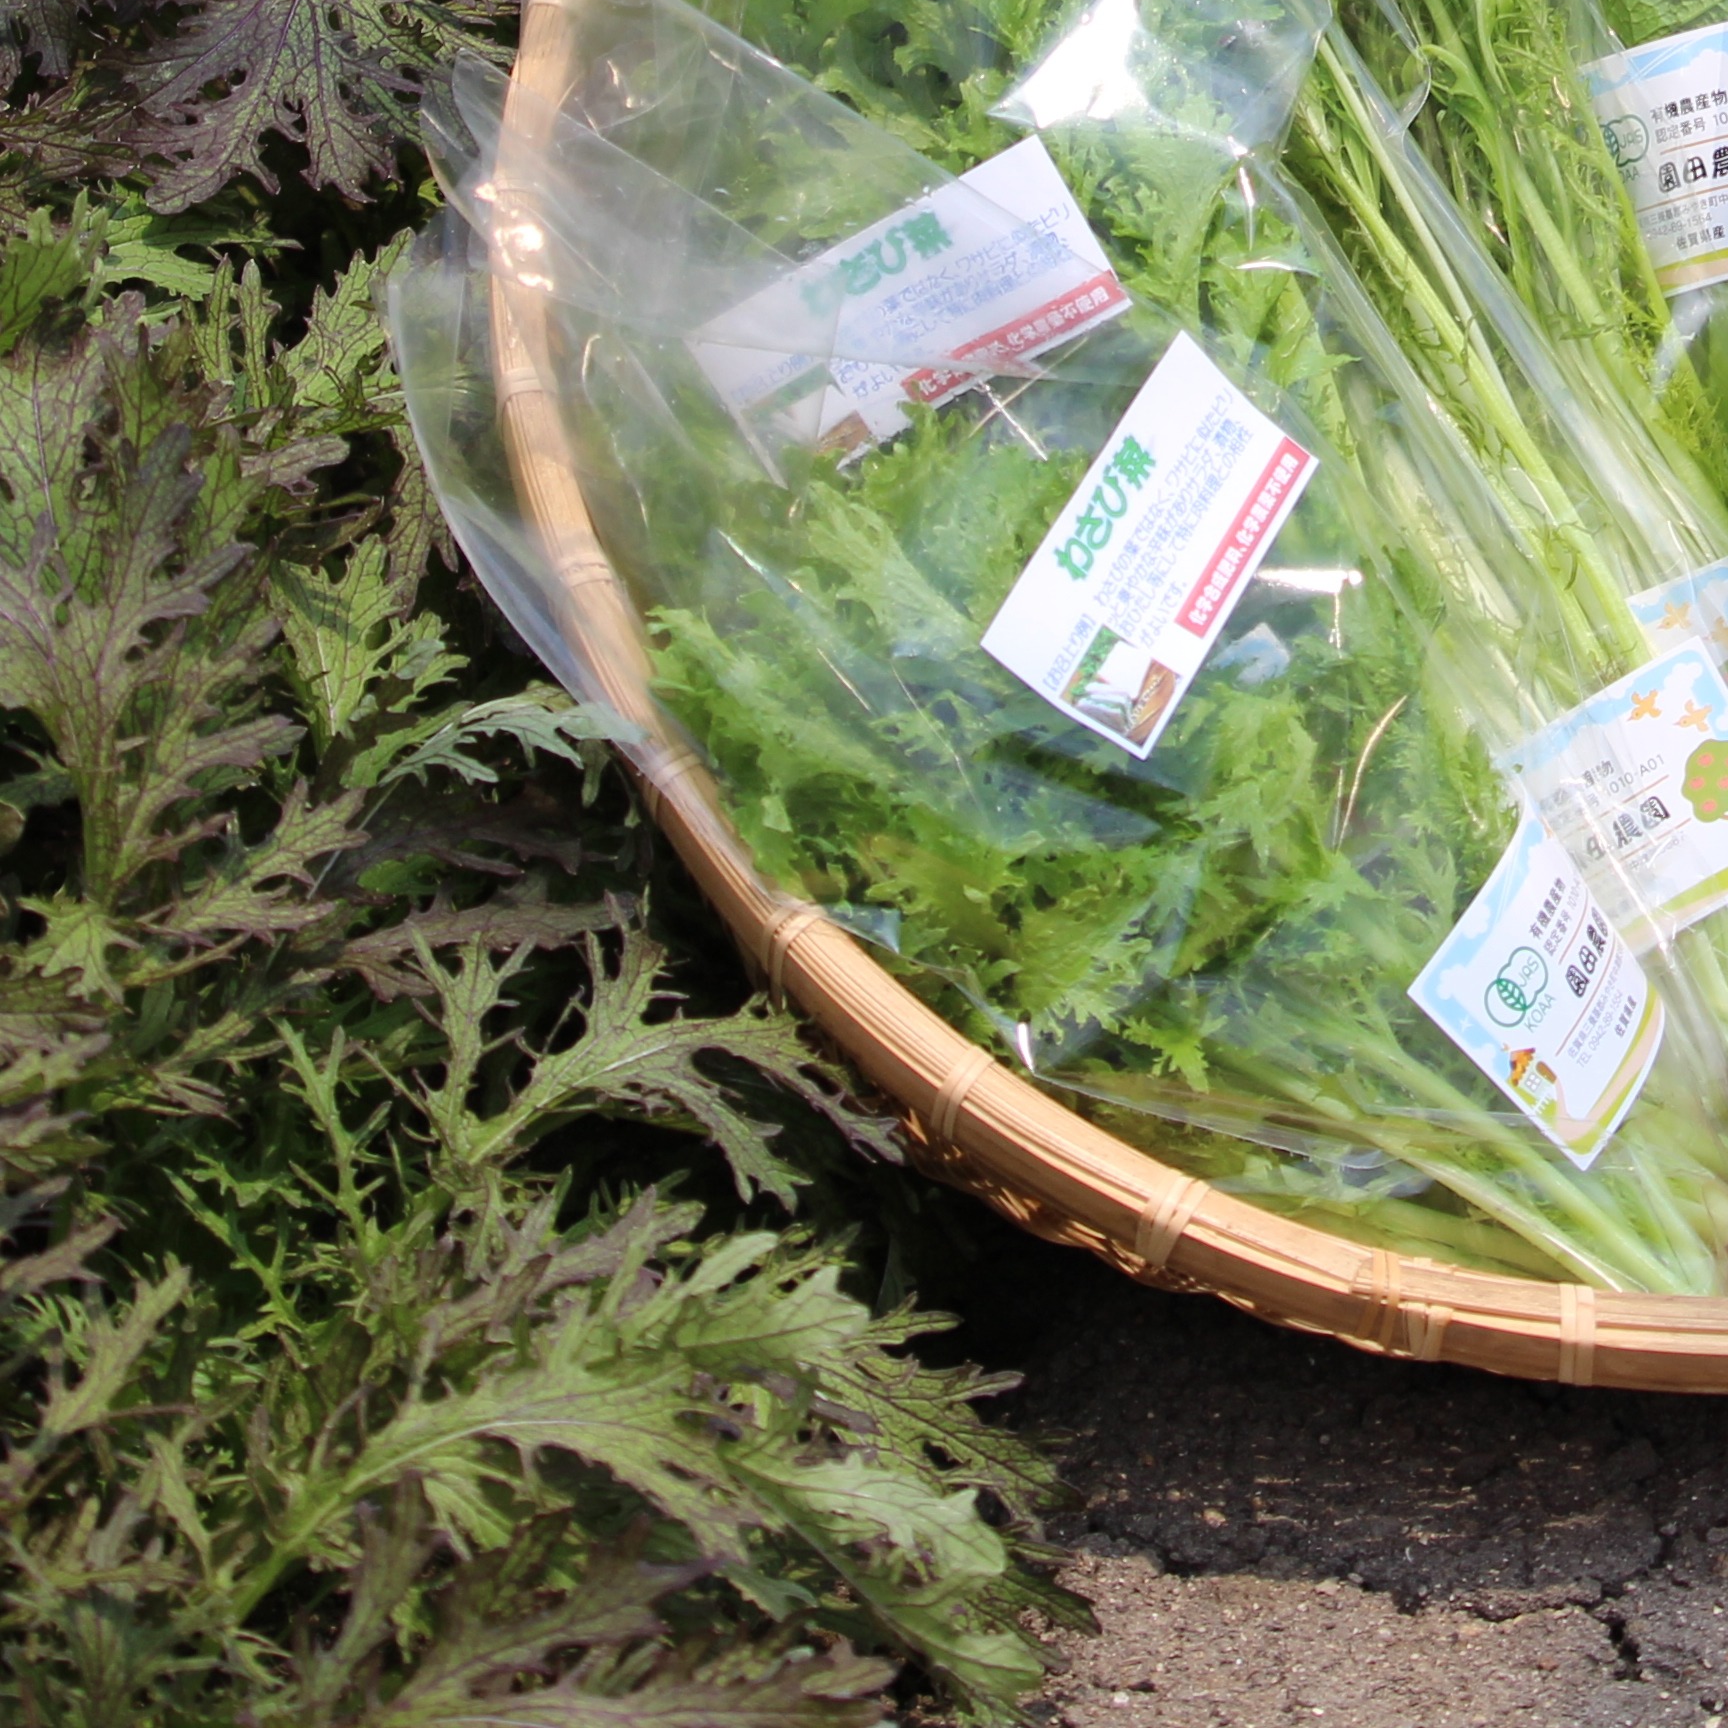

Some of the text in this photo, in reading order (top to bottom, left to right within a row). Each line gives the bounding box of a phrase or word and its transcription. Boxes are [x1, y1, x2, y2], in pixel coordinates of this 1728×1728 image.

[1651, 89, 1728, 123] 有機農産物
[1656, 117, 1706, 144] 認定番号
[1055, 435, 1156, 581] わさび菜
[1529, 878, 1567, 940] 有機農産物
[1544, 911, 1572, 956] 認定番号
[1517, 956, 1540, 991] JAS
[1524, 992, 1557, 1034] KOAA
